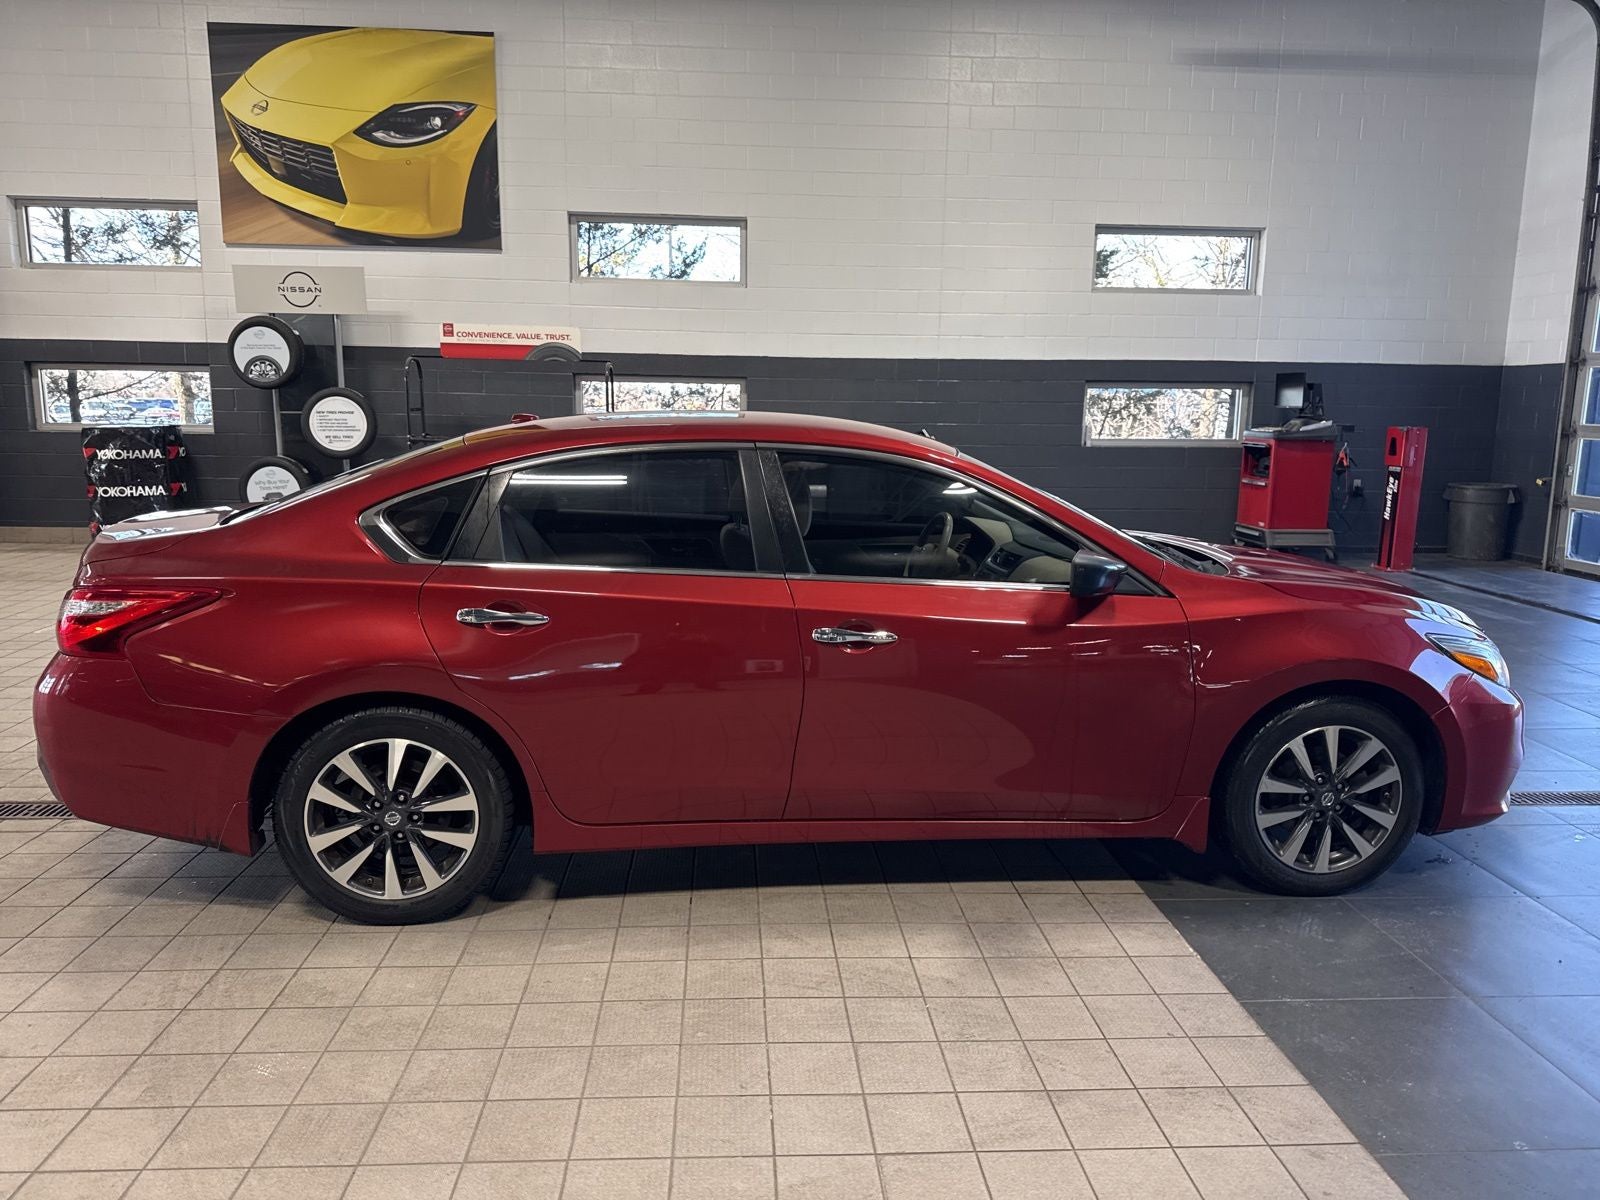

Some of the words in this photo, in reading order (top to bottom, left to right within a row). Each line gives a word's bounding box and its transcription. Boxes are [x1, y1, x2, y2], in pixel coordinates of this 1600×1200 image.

[456, 331, 514, 339] CONVENIENCE.
[516, 332, 543, 340] VALUE.
[545, 333, 572, 341] TRUST.
[96, 448, 162, 460] YOKOHAMA
[95, 485, 166, 498] YOKOHAMA
[1383, 476, 1395, 520] HawkEye
